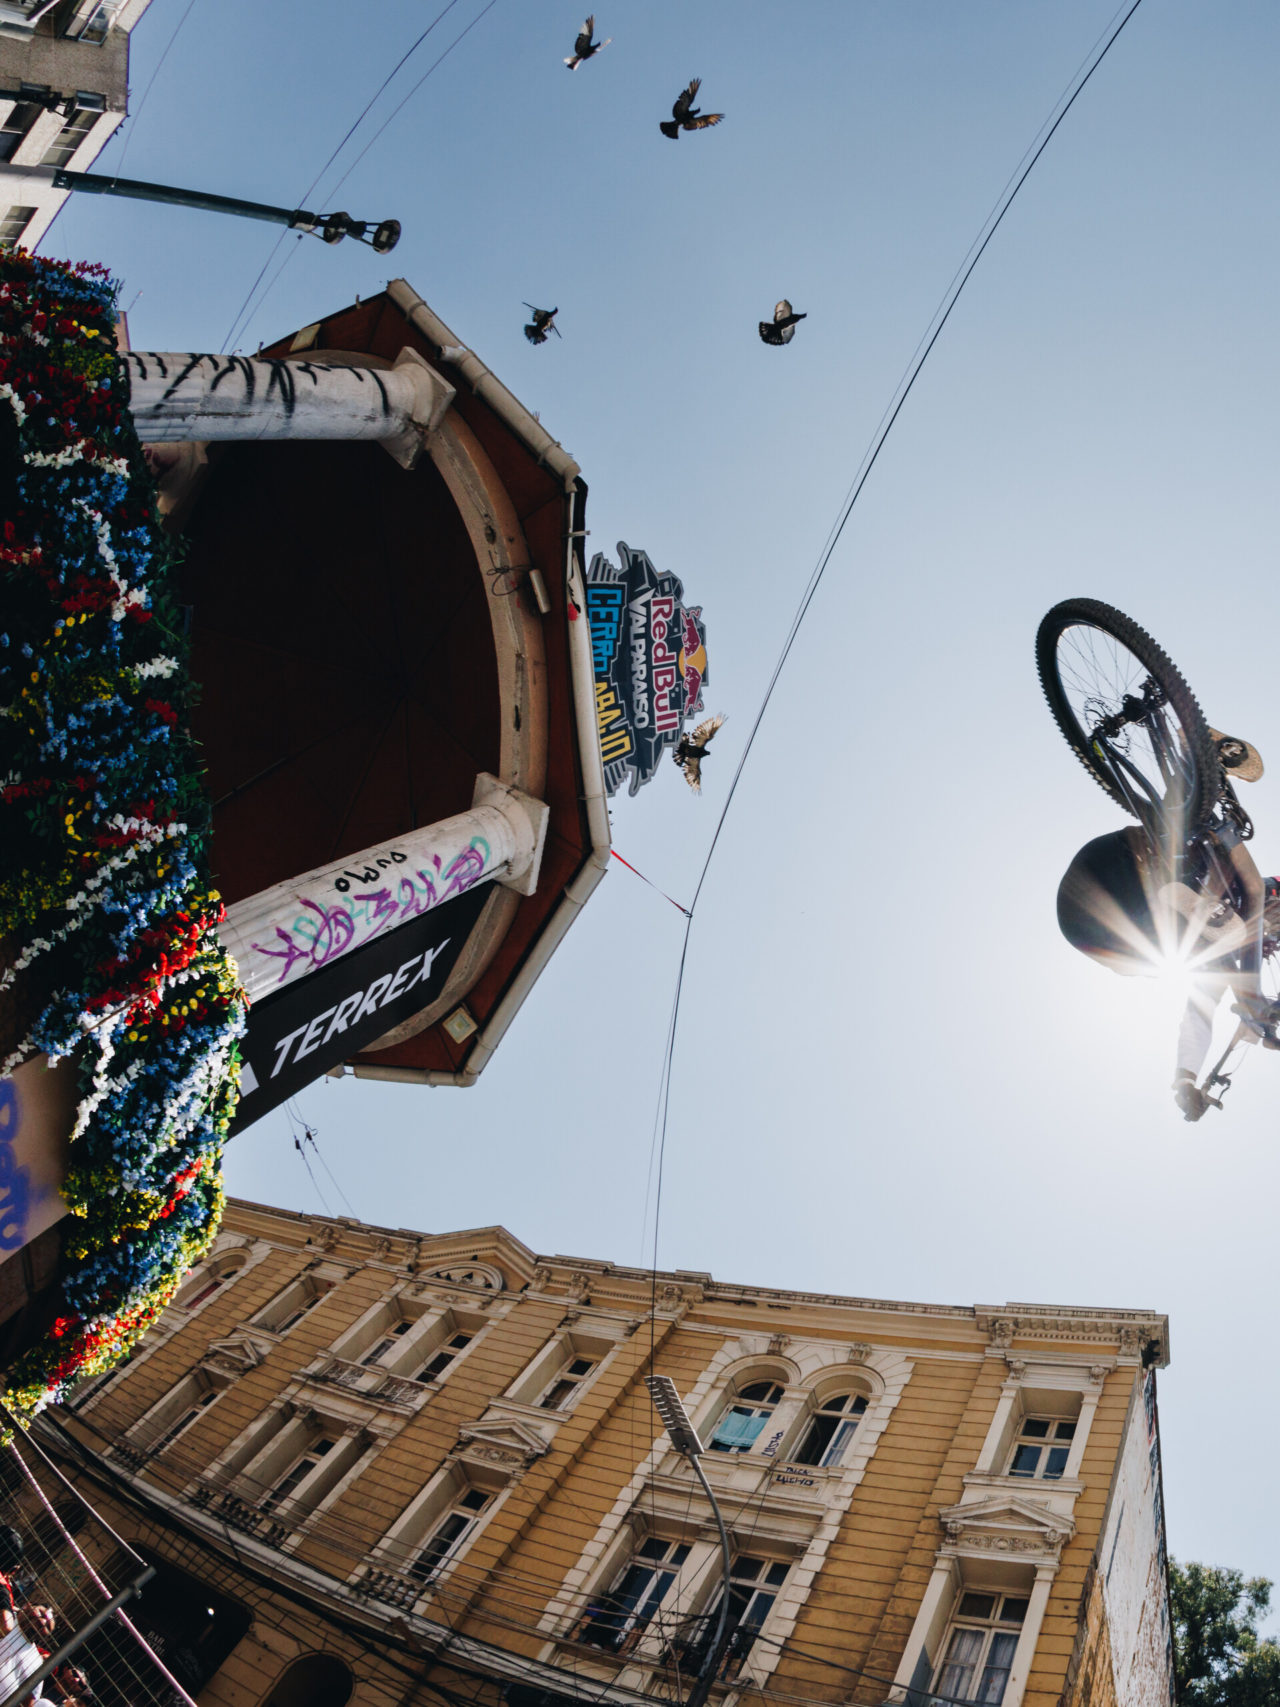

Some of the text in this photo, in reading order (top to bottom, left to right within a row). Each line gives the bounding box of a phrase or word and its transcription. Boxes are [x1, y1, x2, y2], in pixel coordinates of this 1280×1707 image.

[587, 588, 622, 672] CERRO
[628, 588, 656, 730] VALPARAISO
[651, 596, 680, 733] Red Bull
[270, 937, 452, 1079] TERREX
